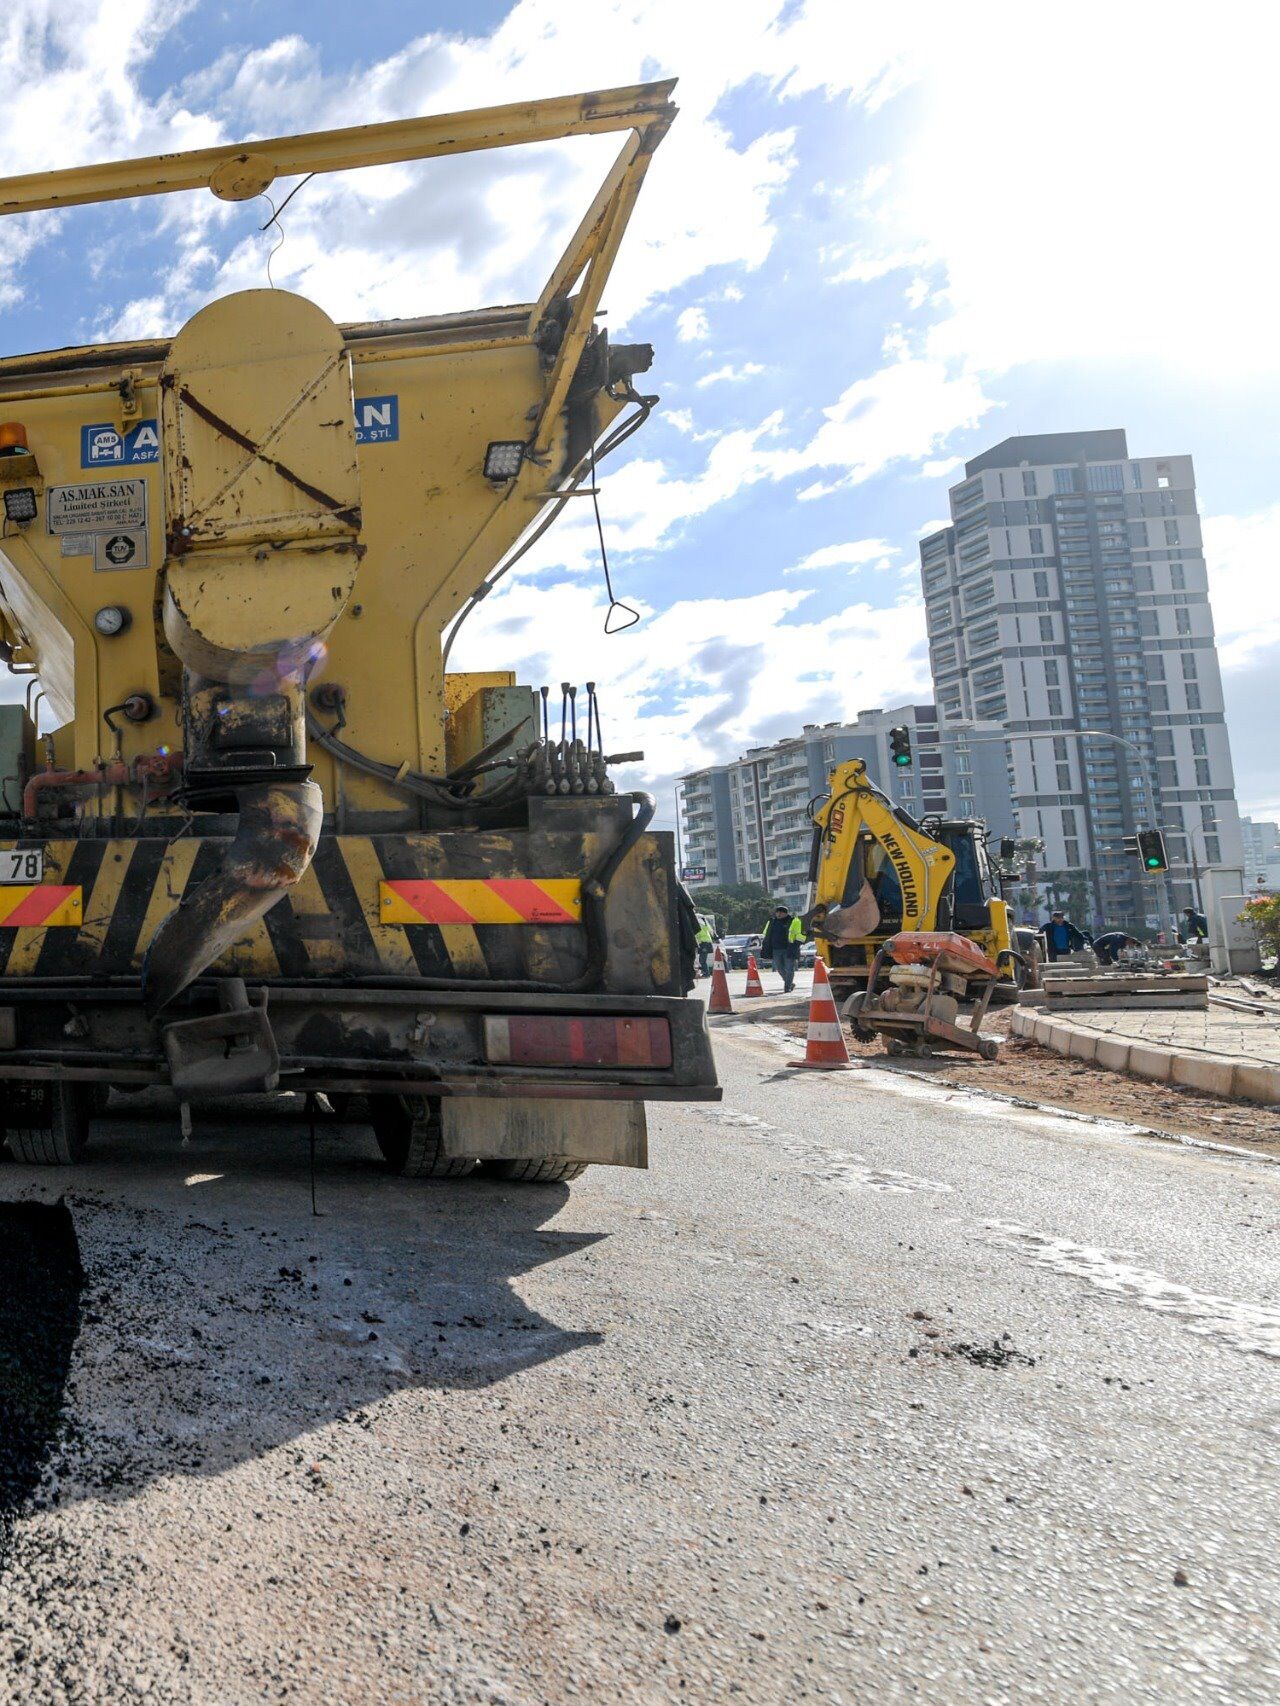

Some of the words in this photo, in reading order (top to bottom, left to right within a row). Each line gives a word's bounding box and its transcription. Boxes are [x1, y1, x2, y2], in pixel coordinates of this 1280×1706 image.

[97, 435, 116, 444] AMS
[59, 484, 135, 502] AS.MAK.SAN
[64, 502, 97, 512] Limited
[11, 854, 38, 879] 78
[880, 832, 904, 860] NEW
[896, 861, 919, 918] HOLLAND
